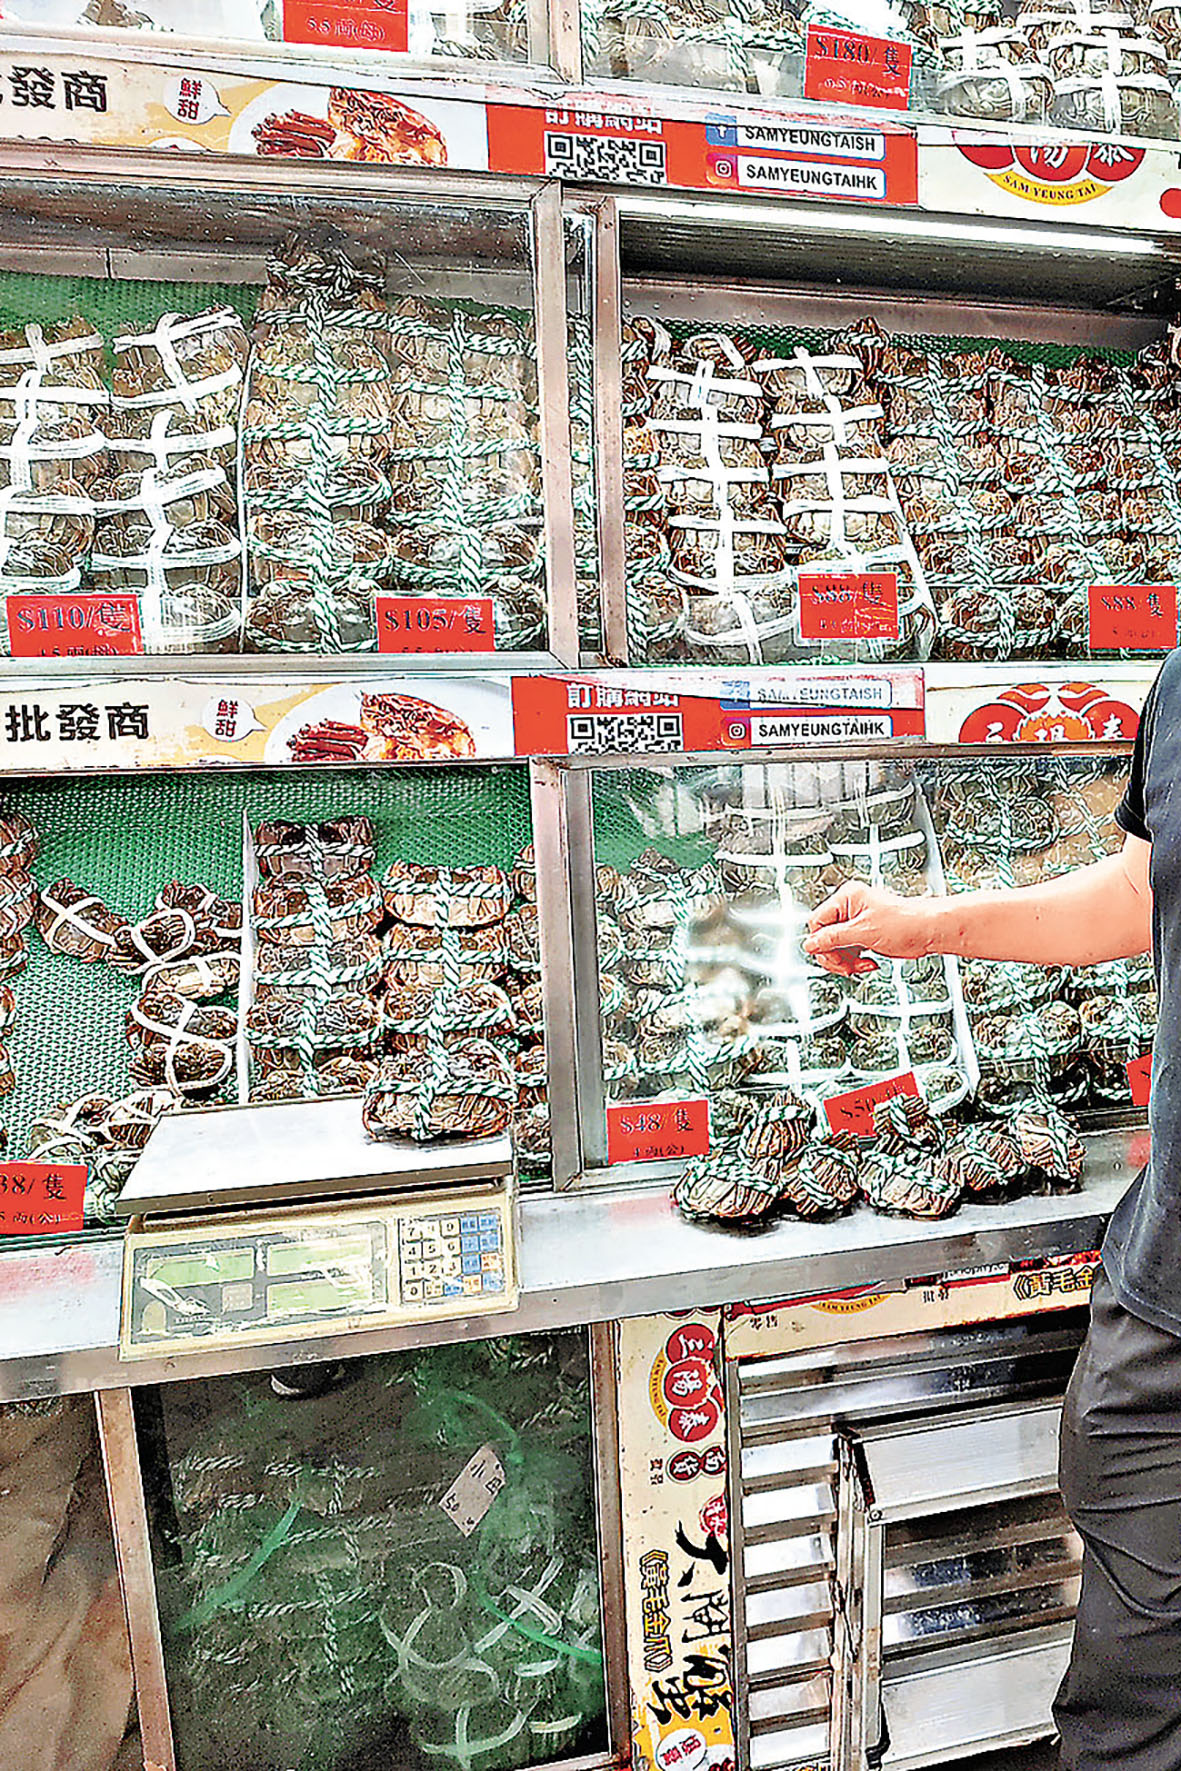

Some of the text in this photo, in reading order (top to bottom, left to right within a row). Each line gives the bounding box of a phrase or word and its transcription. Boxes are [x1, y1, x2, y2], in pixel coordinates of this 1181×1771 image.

[745, 163, 877, 191] SAMYEUNGTAIHK
[1003, 174, 1096, 200] SAM YEUNG TAI
[5, 702, 149, 741] 批發商
[215, 699, 239, 737] 鮮甜
[759, 722, 885, 738] SAMYEUNGTAIHK
